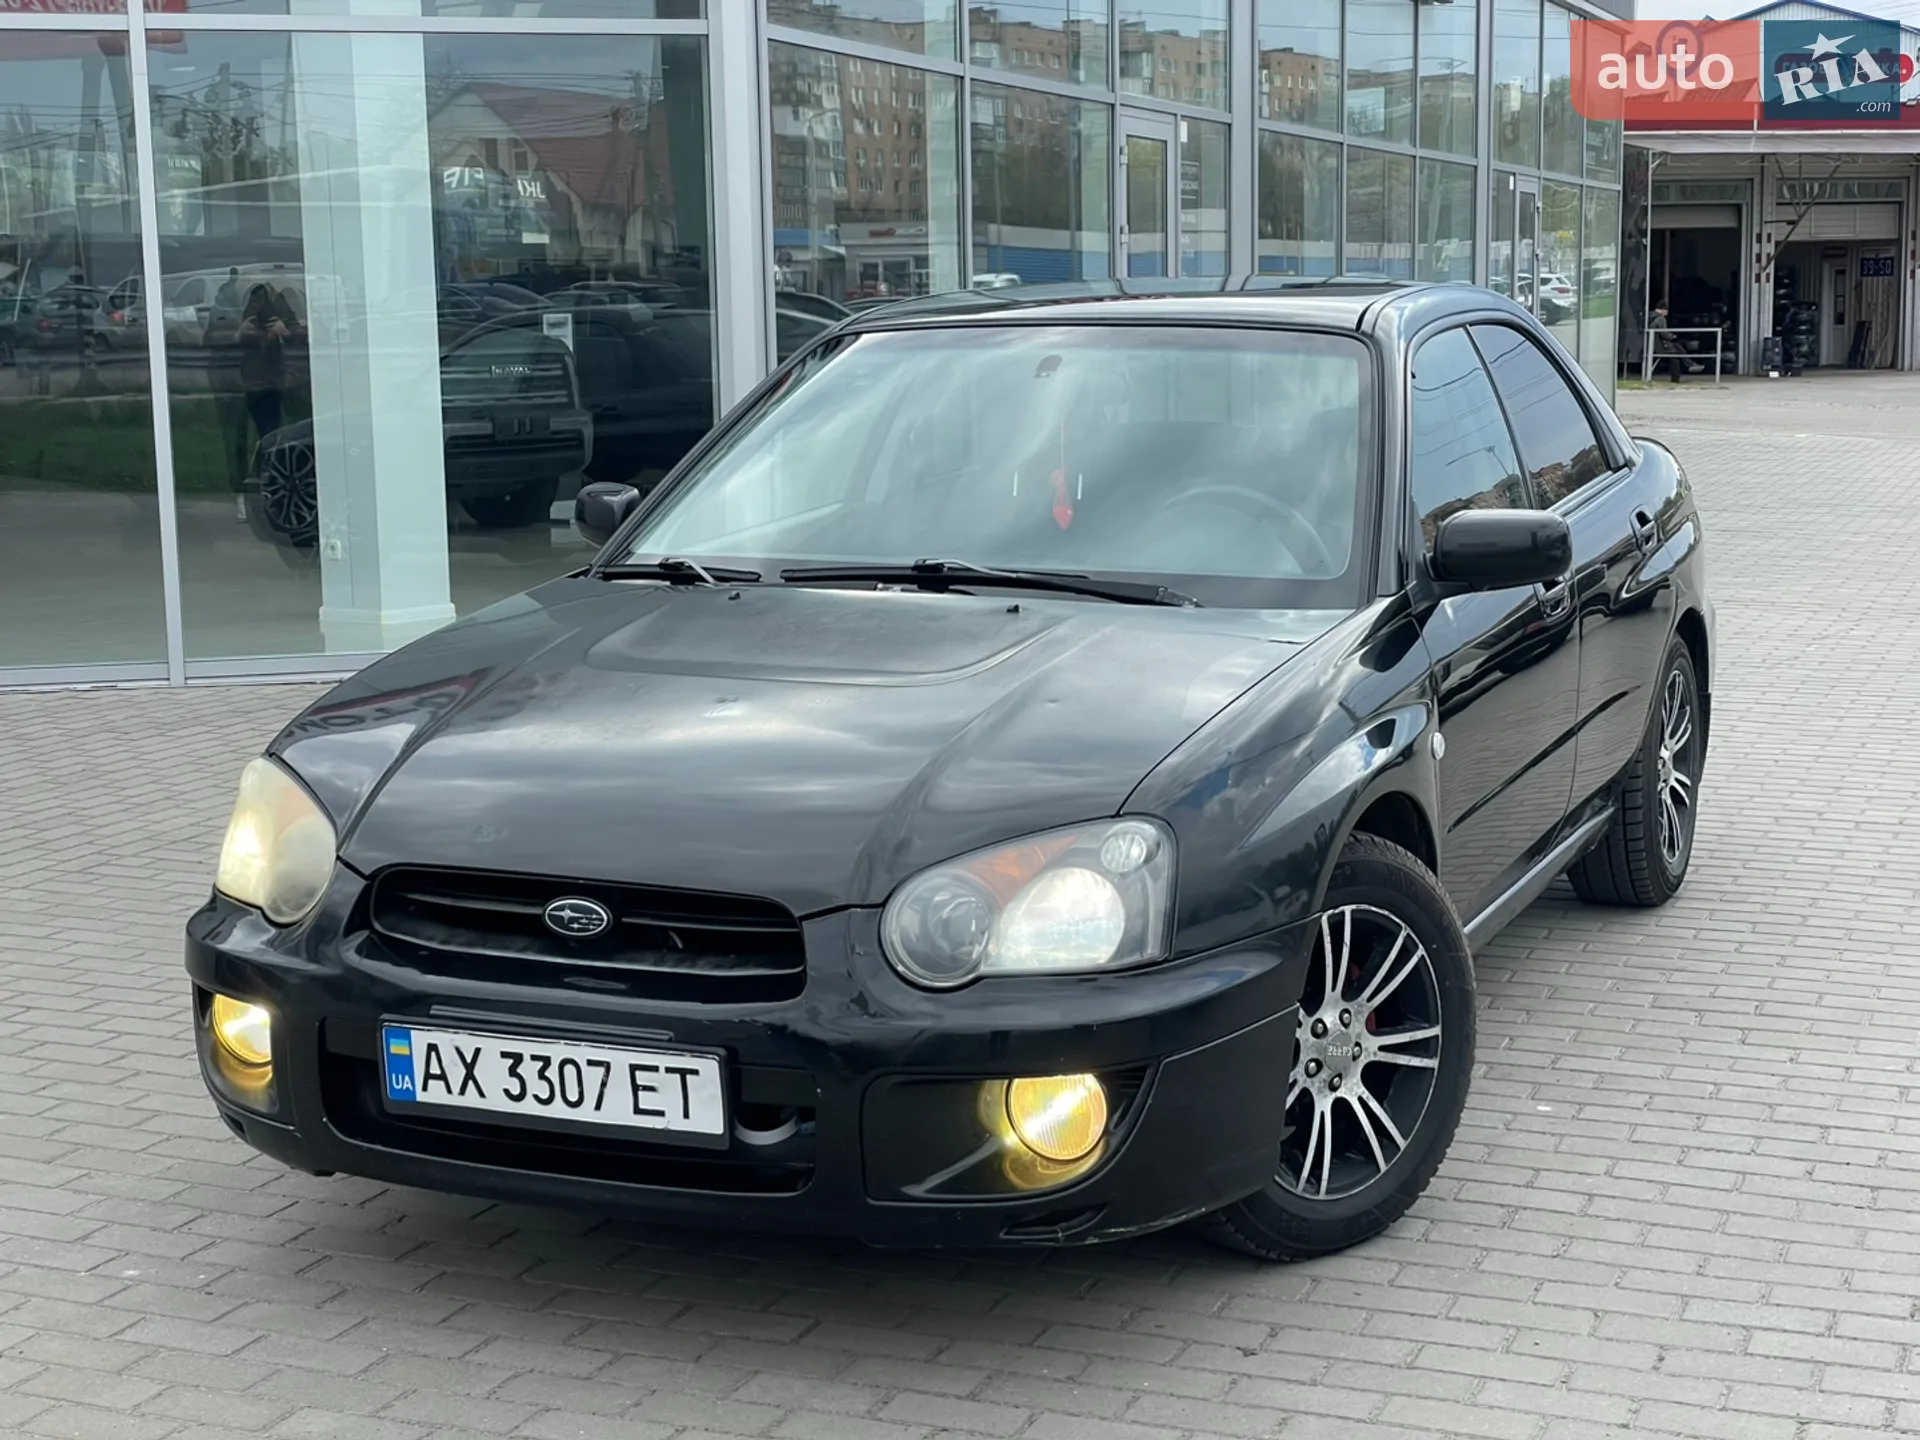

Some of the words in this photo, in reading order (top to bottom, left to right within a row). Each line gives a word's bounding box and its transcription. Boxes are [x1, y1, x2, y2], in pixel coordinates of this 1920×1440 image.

[391, 1073, 414, 1091] UA
[421, 1042, 487, 1099] AX
[499, 1050, 612, 1112] 3307
[628, 1062, 700, 1120] ET
